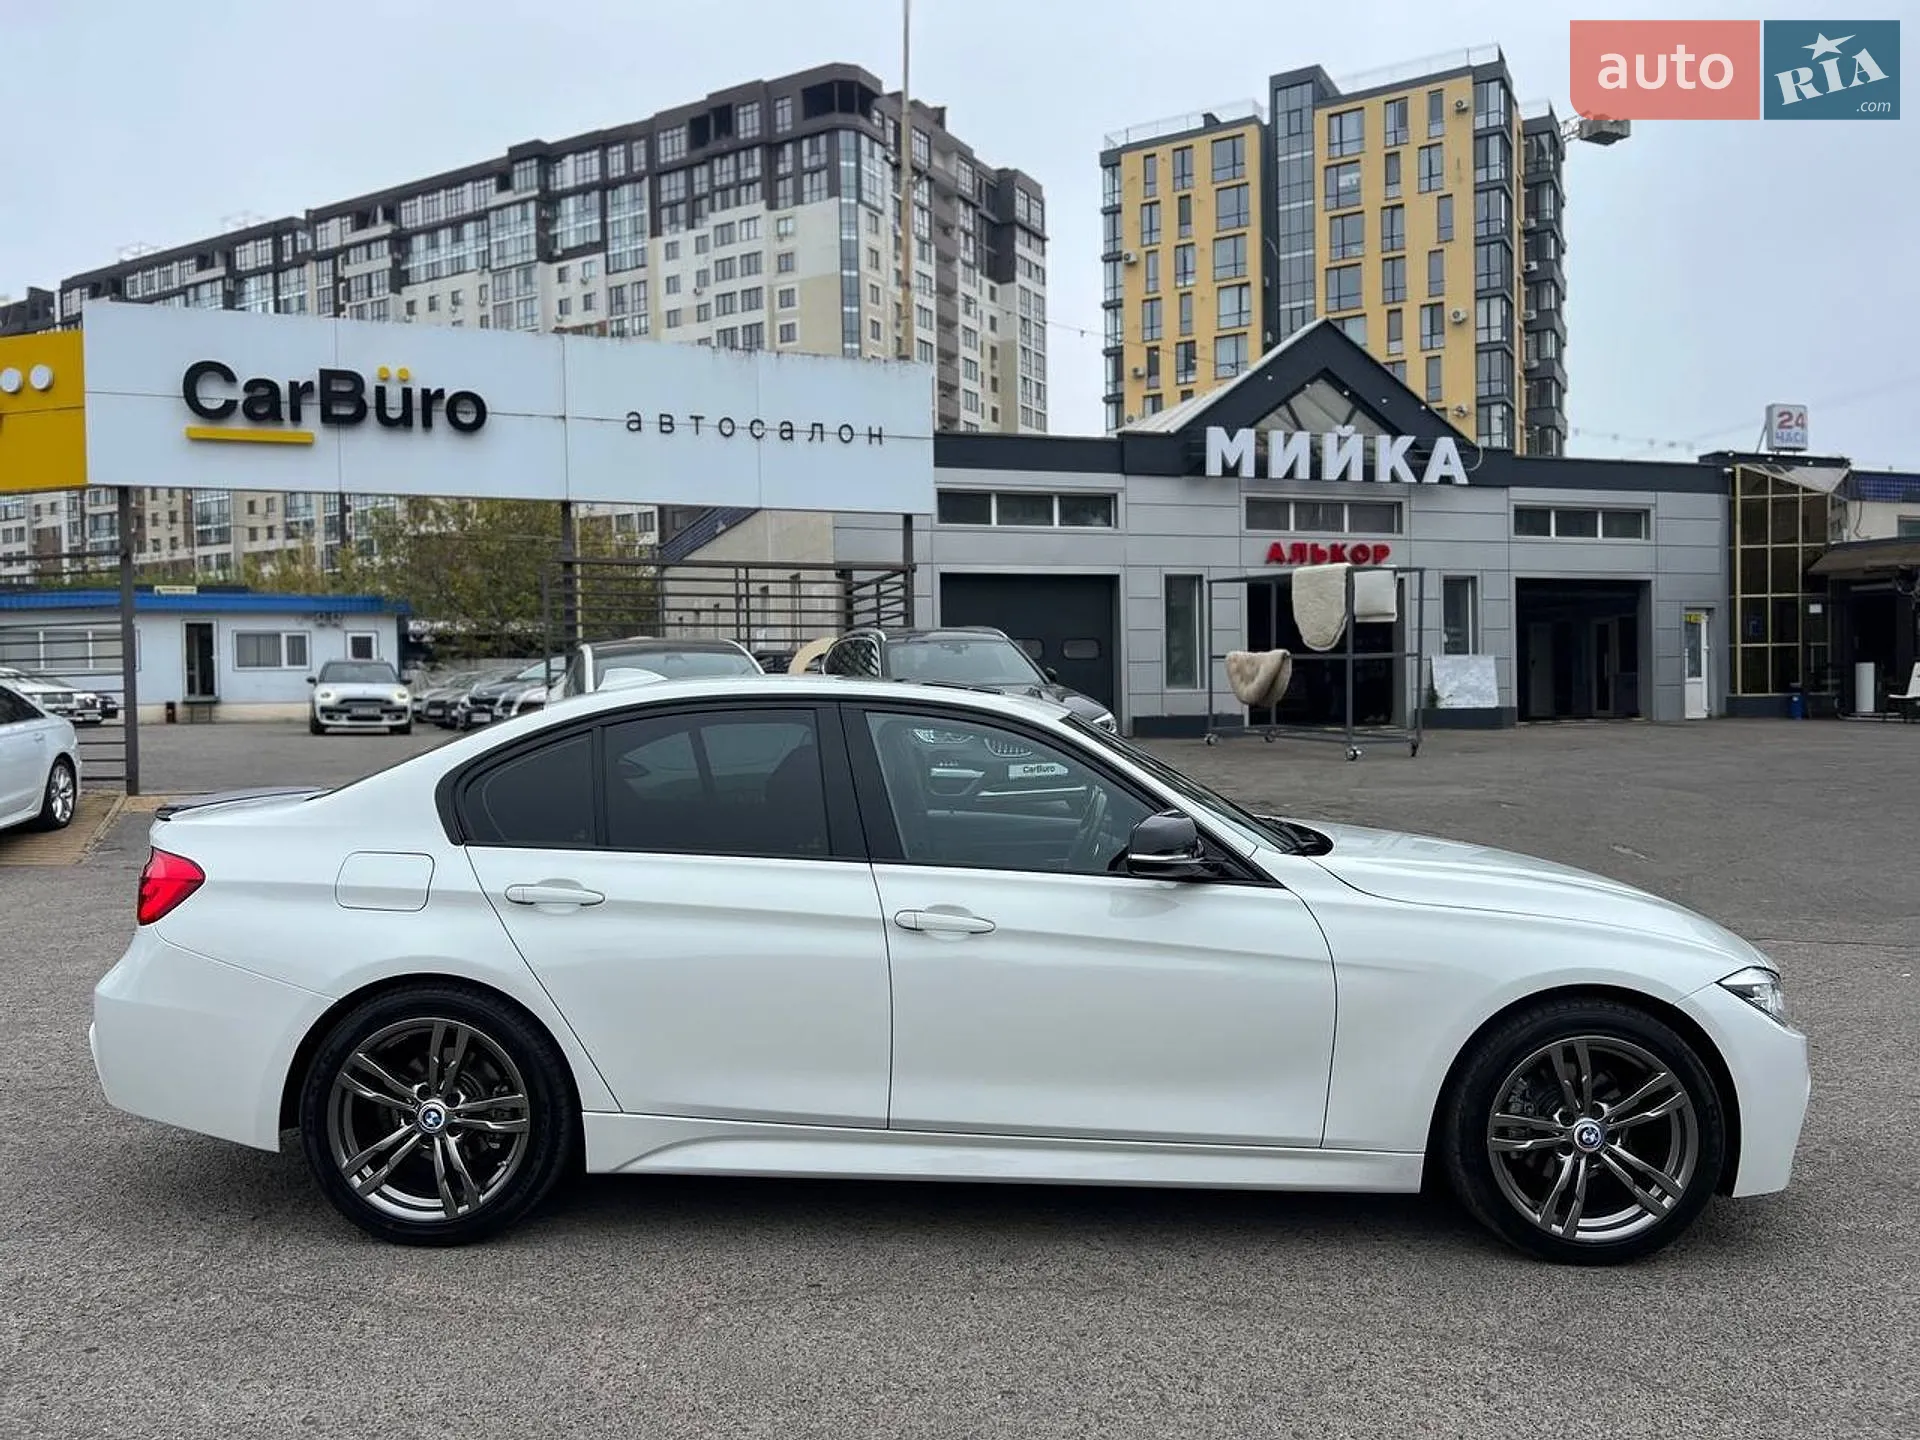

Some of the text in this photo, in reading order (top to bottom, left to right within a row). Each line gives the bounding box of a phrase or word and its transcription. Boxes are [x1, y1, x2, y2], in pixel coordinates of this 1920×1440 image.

[182, 360, 488, 432] CarBüro
[626, 411, 883, 445] автосалон
[1777, 411, 1806, 430] 24
[1206, 425, 1469, 485] МИЙКА
[1266, 542, 1392, 565] АЛЬКОР
